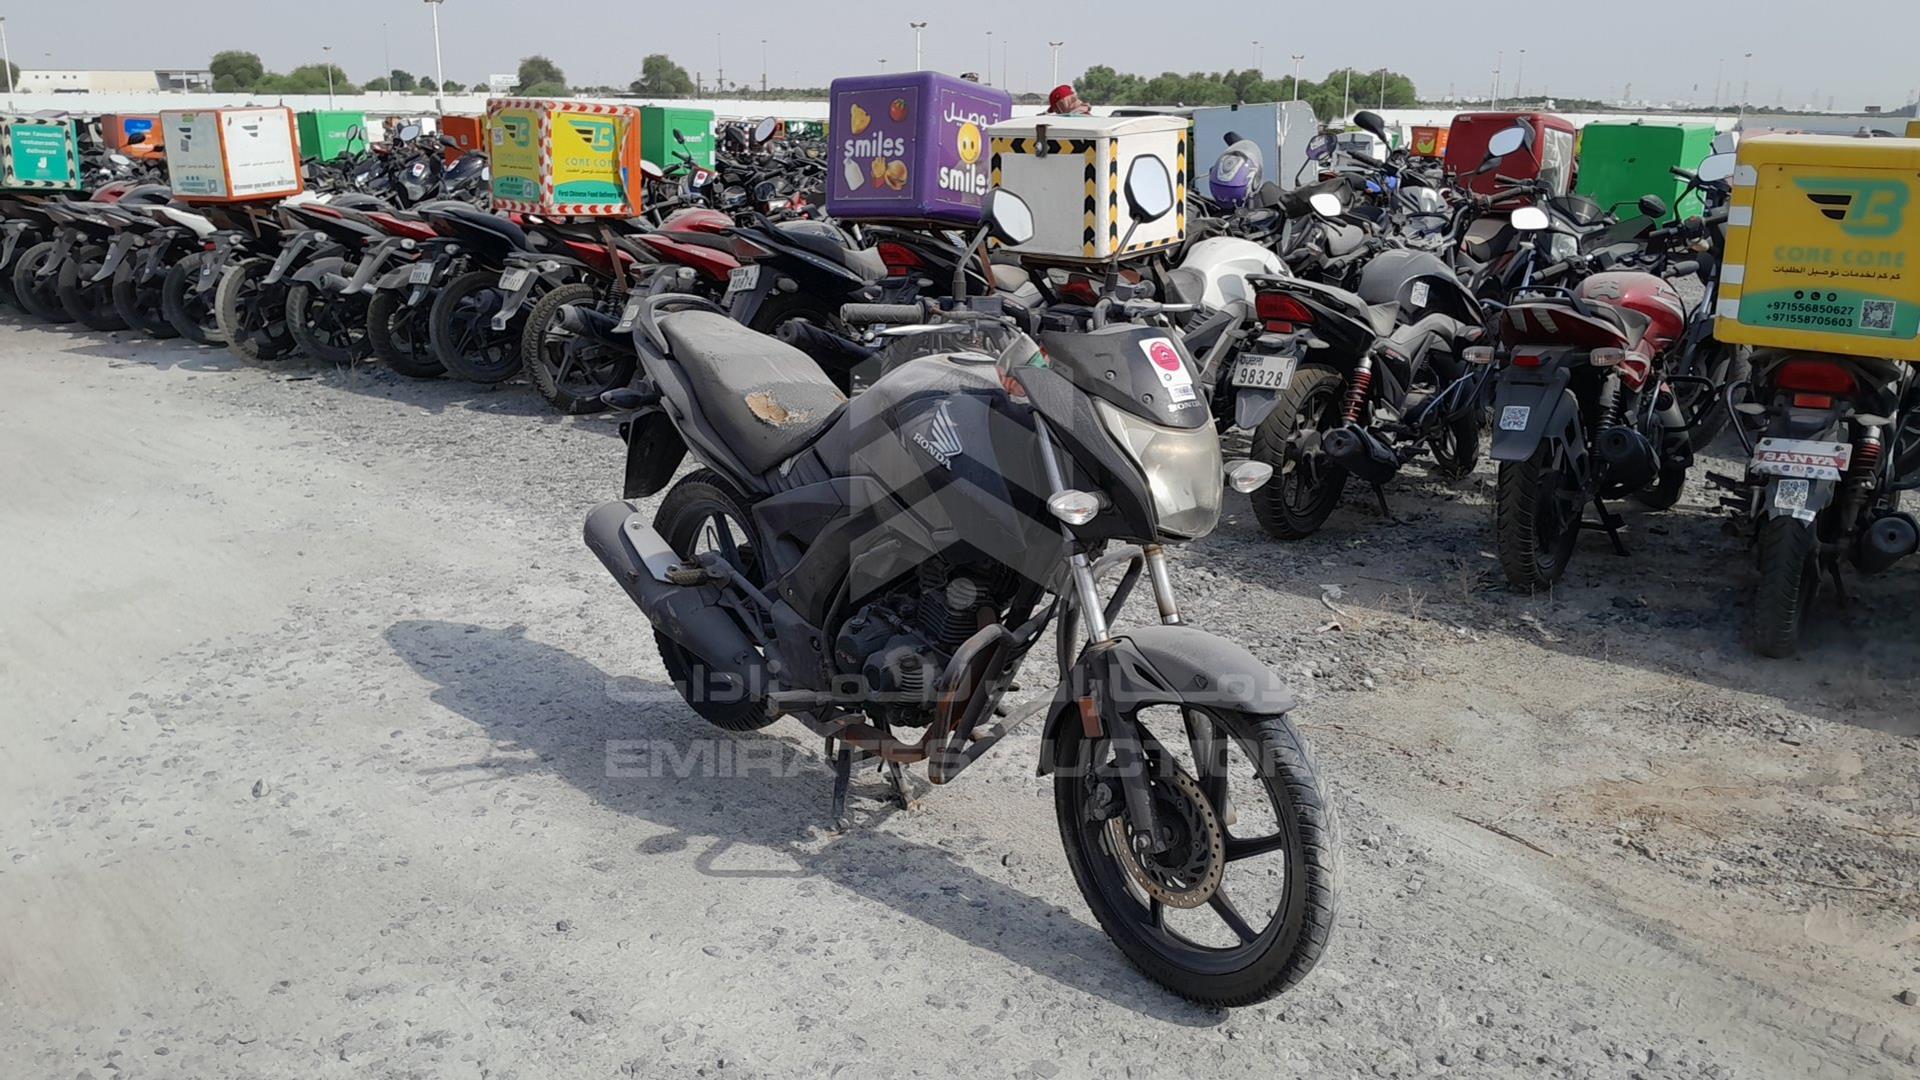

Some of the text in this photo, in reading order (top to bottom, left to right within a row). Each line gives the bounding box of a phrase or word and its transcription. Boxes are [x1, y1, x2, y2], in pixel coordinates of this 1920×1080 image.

[943, 102, 999, 131] توصيل
[844, 131, 904, 158] smiles
[940, 164, 989, 195] smile
[1773, 246, 1905, 269] COME COME
[1767, 301, 1854, 315] +971556850627
[1766, 312, 1853, 328] +971558705603
[1240, 368, 1283, 387] 98328
[912, 432, 952, 471] HONDA
[1762, 452, 1837, 467] SANYA
